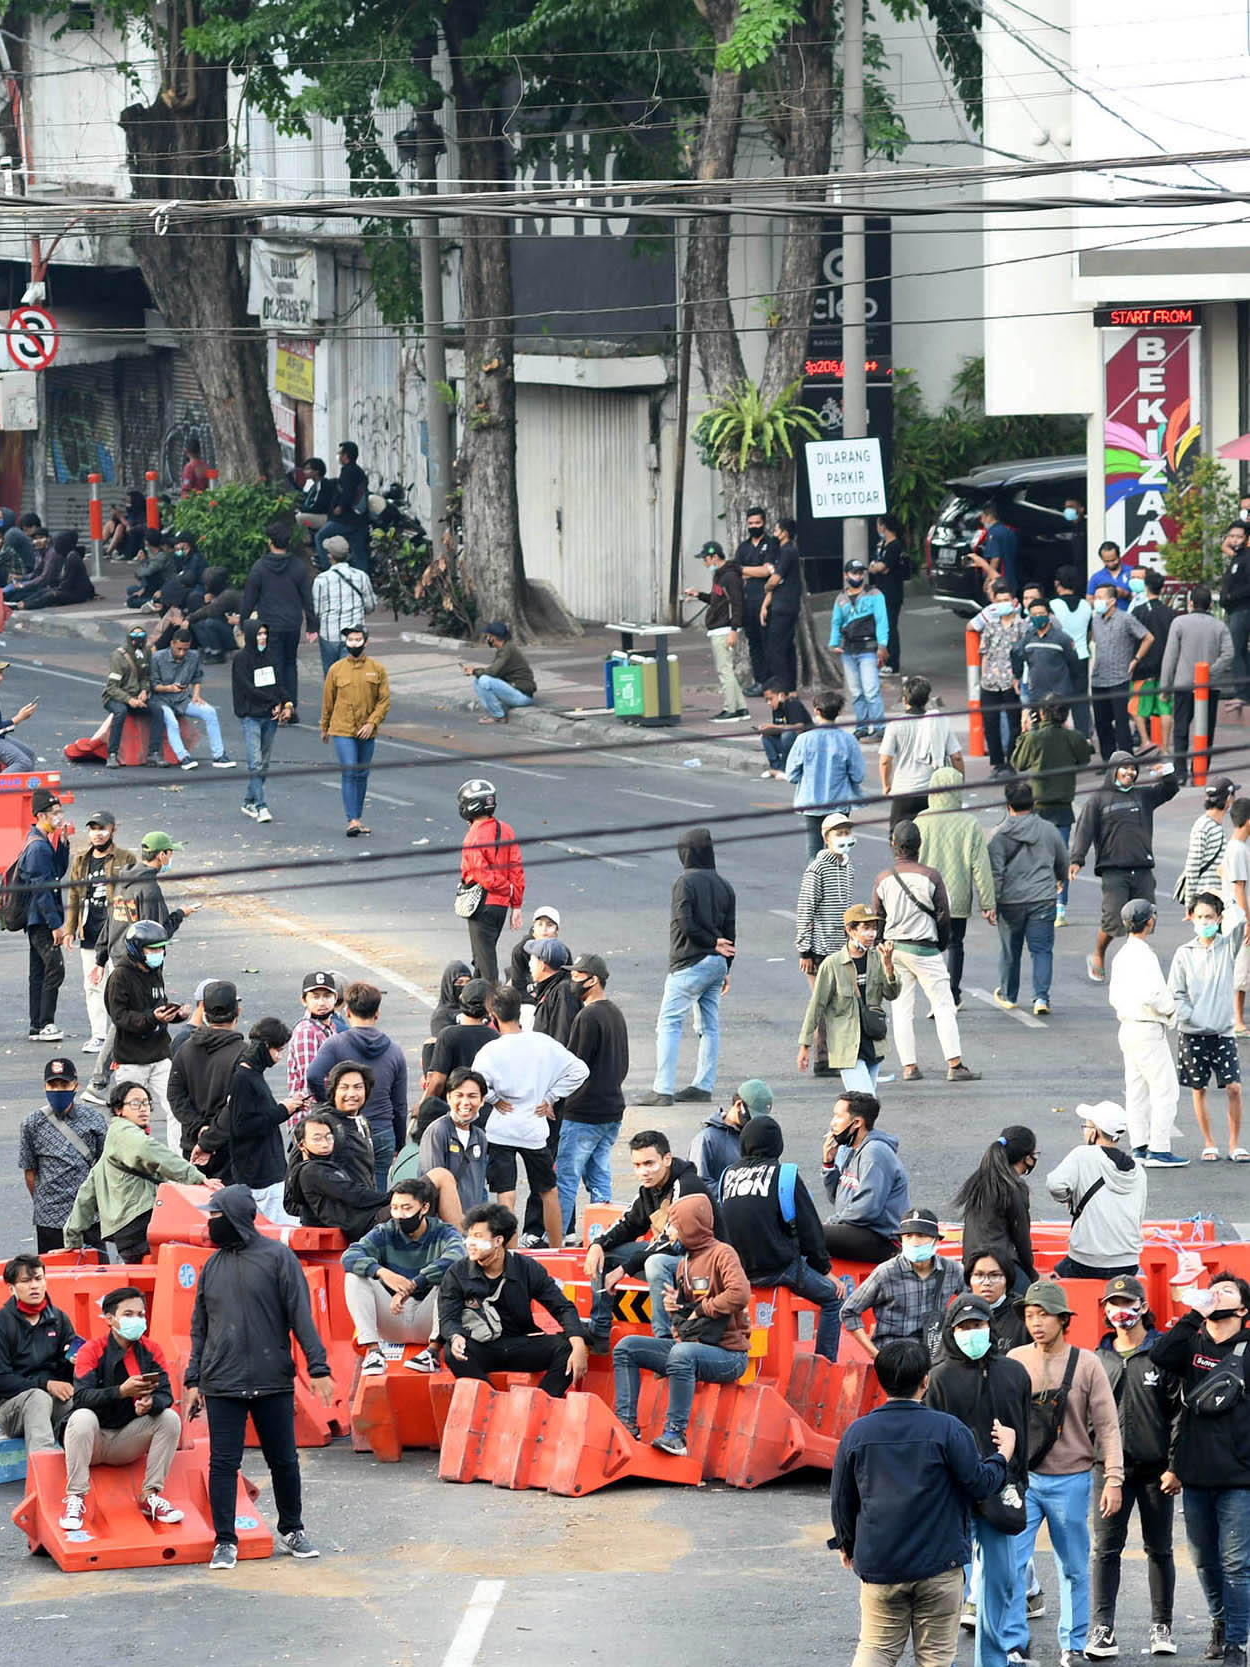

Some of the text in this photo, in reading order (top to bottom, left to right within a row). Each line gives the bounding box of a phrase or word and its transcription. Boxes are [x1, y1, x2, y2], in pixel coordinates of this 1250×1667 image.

[1111, 308, 1193, 324] START FROM
[19, 316, 45, 358] S
[816, 449, 871, 465] DILARANG
[1136, 336, 1169, 577] BEKIZAAR
[827, 470, 865, 484] PARKIR
[816, 490, 880, 507] DI TROTOAR
